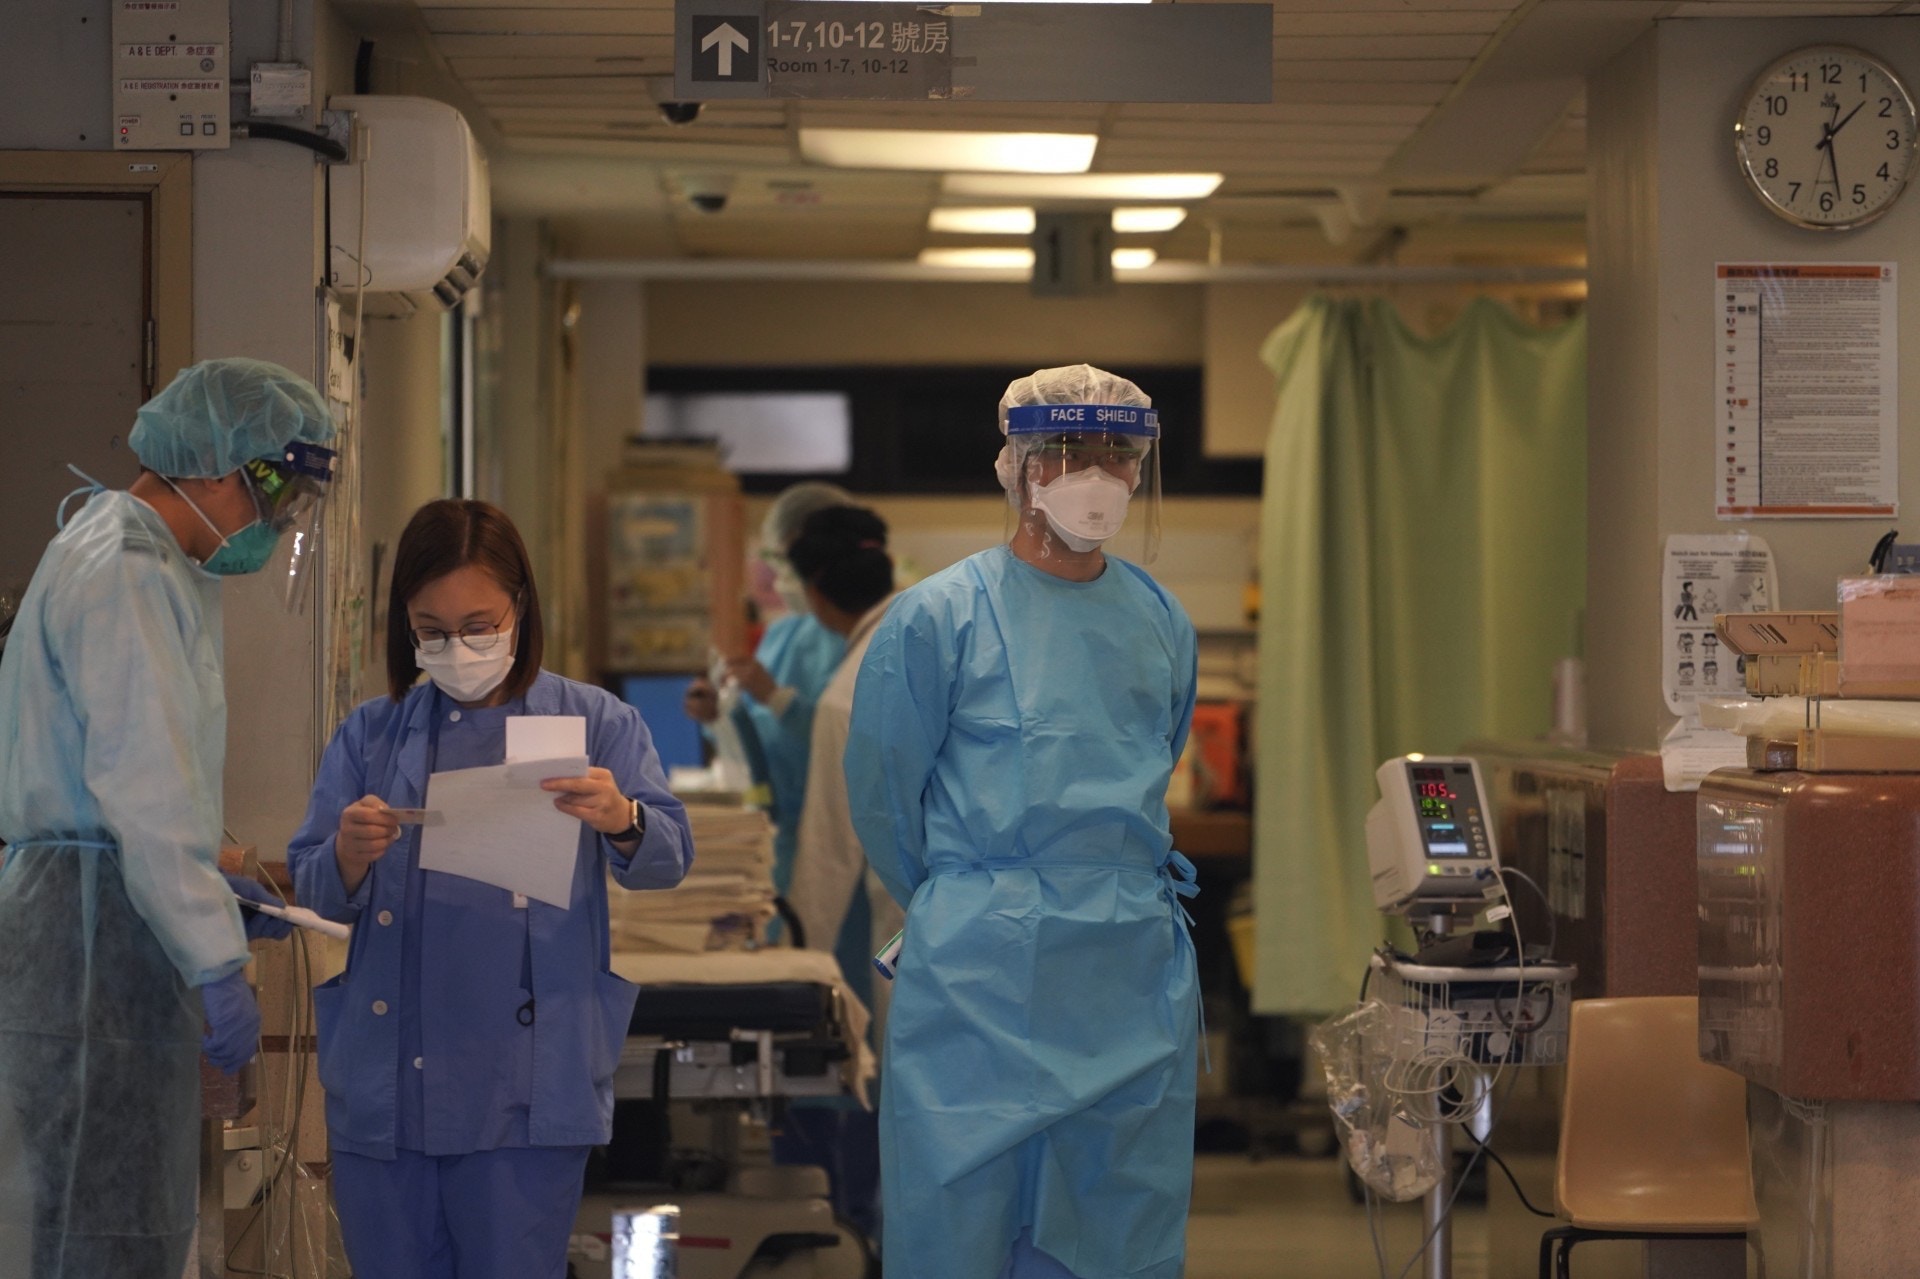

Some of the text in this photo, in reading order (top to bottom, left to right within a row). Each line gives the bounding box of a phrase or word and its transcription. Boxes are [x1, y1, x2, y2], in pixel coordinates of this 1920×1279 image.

[767, 21, 950, 54] 1-7,10-12 號房
[129, 46, 135, 56] A
[138, 46, 143, 56] &
[146, 46, 151, 56] E
[767, 57, 908, 75] Room 1-7, 10-12
[1820, 63, 1842, 84] 12
[141, 82, 179, 90] REGISTRATION
[1789, 72, 1808, 92] 11
[1859, 73, 1866, 93] 1
[1765, 95, 1788, 116] 10
[1878, 97, 1892, 118] 2
[1757, 126, 1771, 146] 9
[1886, 129, 1899, 150] 3
[1765, 158, 1779, 178] 8
[1875, 161, 1890, 182] 4
[1788, 182, 1802, 202] 7
[1819, 191, 1833, 212] 6
[1852, 184, 1866, 205] 5
[1050, 408, 1137, 423] FACE SHIELD
[1422, 783, 1448, 798] 105
